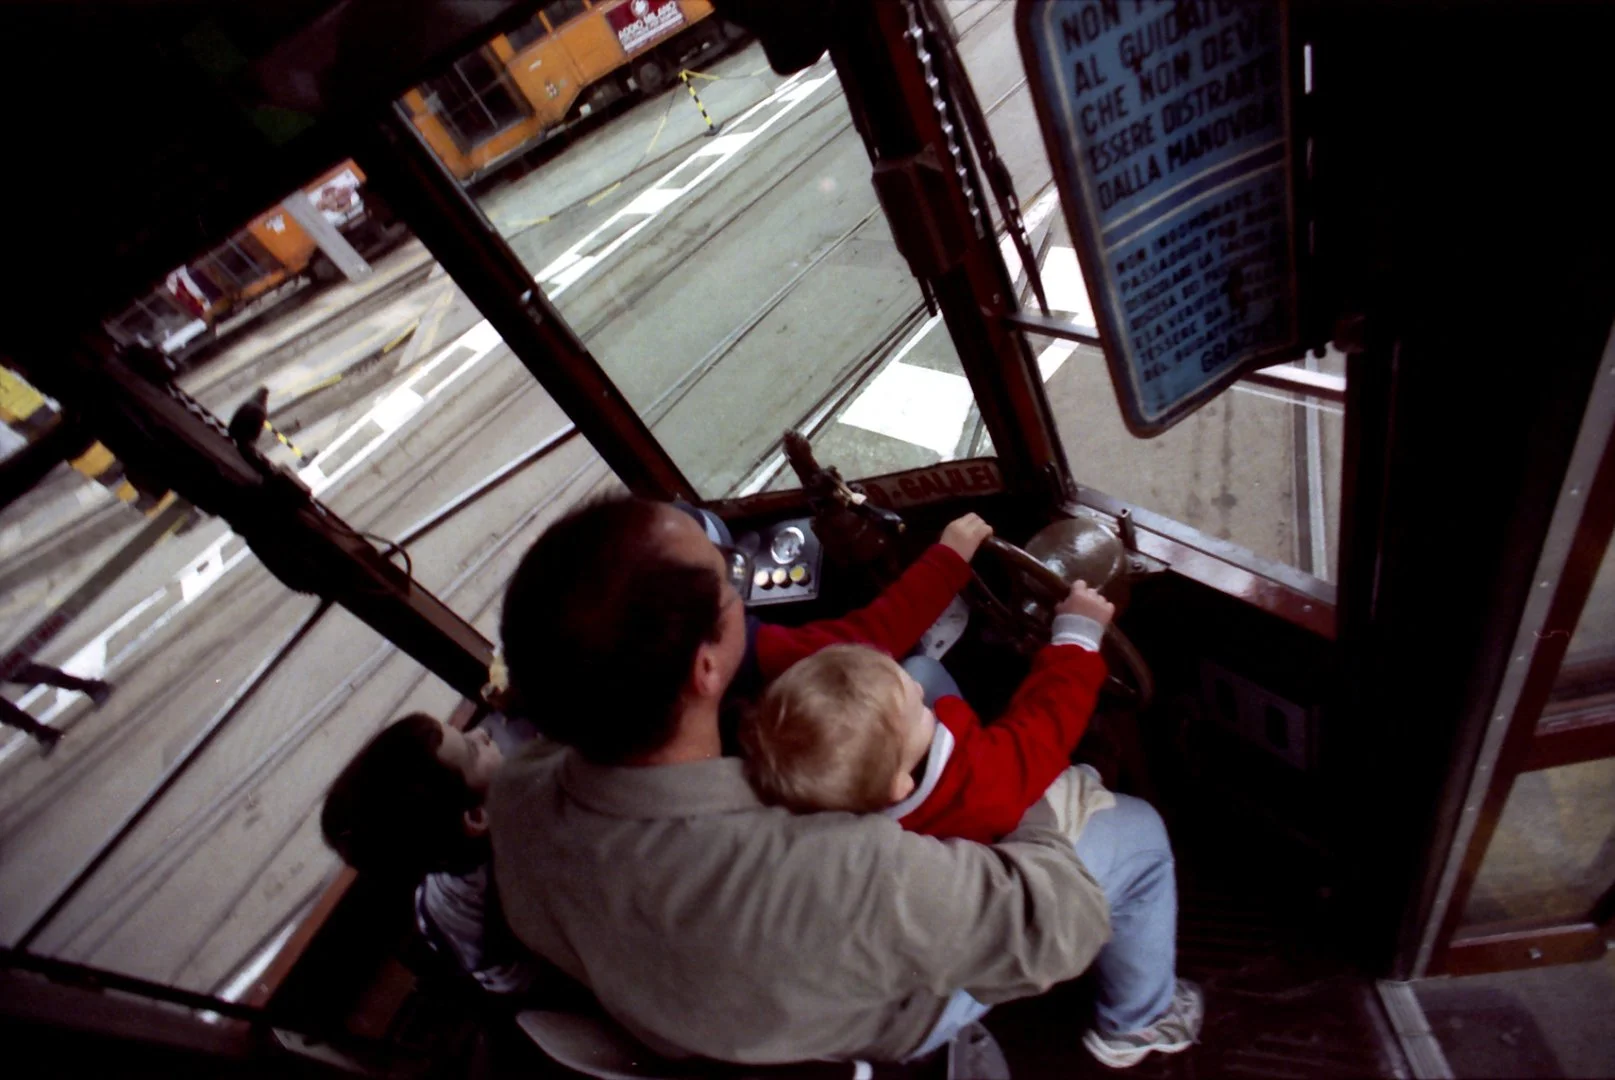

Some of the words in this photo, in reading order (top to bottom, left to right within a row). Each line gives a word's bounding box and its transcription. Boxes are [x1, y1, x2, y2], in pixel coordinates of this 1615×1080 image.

[1061, 0, 1120, 52] NON
[1073, 55, 1107, 97] AL
[1119, 0, 1238, 68] GUIDATO
[1081, 84, 1129, 136] CHE
[1138, 50, 1191, 104] NON
[1088, 116, 1155, 174] ESSERE
[1097, 153, 1161, 210] DALLA
